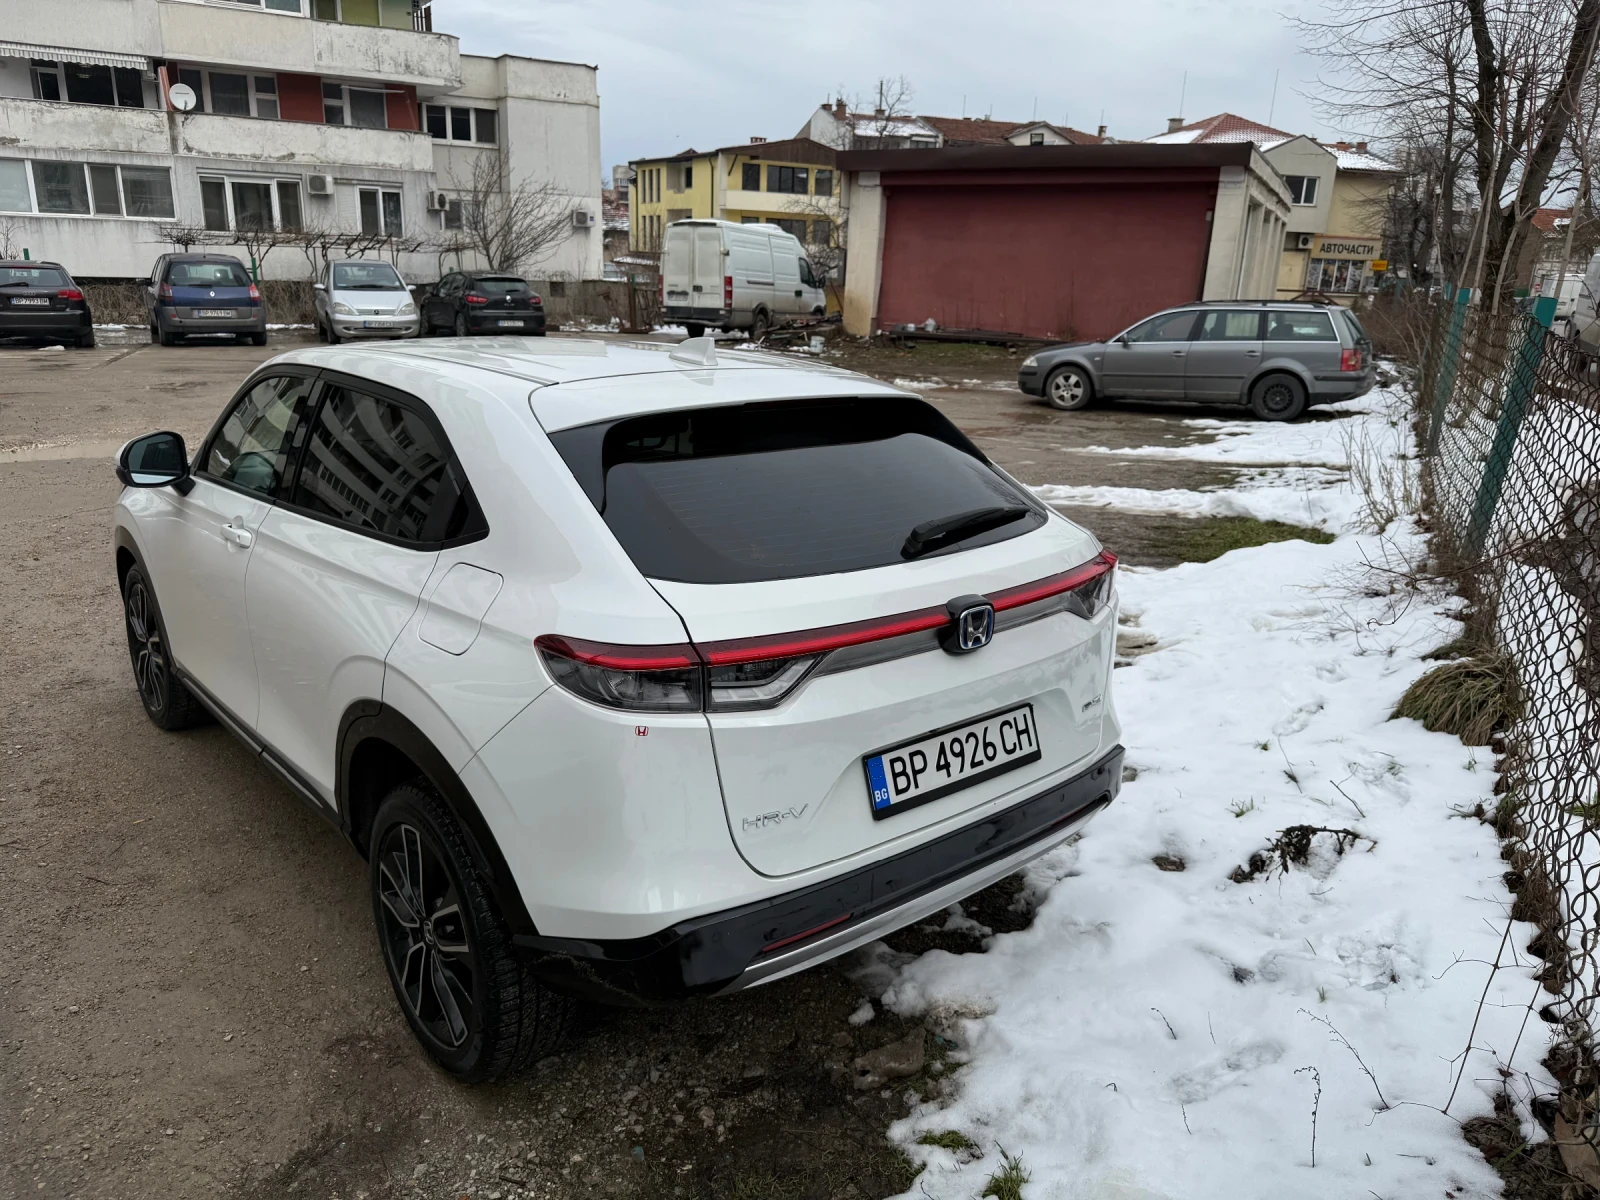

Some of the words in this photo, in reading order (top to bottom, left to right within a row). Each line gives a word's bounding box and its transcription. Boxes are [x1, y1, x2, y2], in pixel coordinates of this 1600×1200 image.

[1320, 243, 1374, 255] АВТОЧАСТИ
[889, 750, 928, 796] BP
[936, 726, 997, 778] 4926
[999, 713, 1033, 755] CH
[874, 788, 888, 802] BG
[742, 803, 809, 831] HR-V
